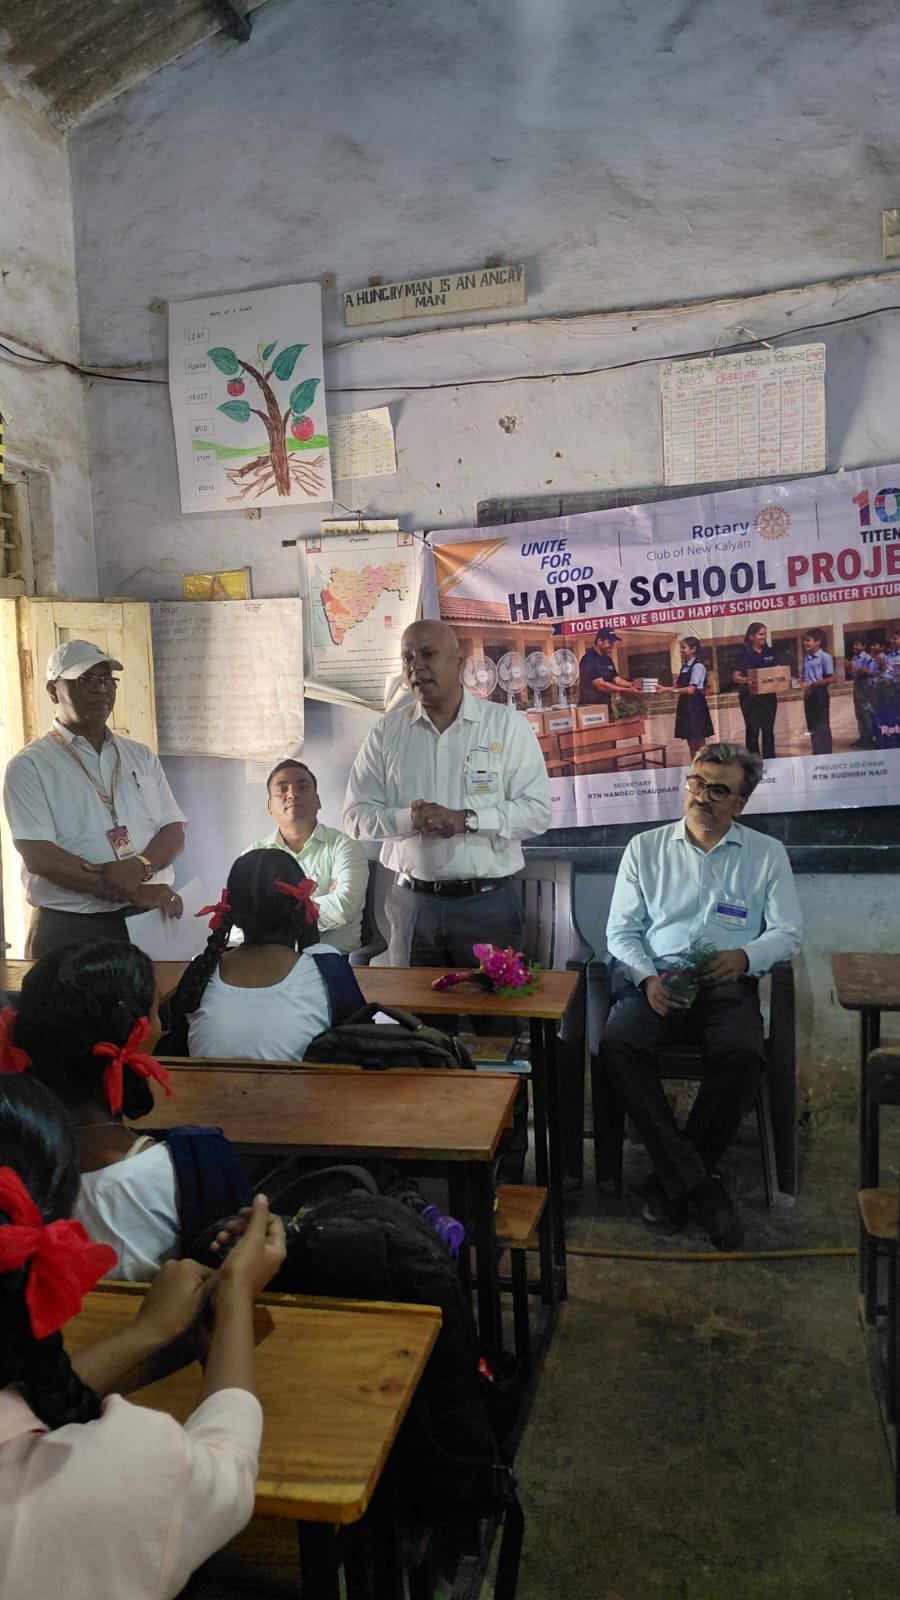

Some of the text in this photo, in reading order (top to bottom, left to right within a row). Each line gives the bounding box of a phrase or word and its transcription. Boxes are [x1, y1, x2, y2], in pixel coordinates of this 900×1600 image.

[346, 268, 523, 308] A HUNGRY MAN IS AN ANGRY
[415, 294, 446, 309] MAN
[187, 331, 205, 341] LEAF
[190, 392, 208, 401] FRUIT
[692, 521, 750, 540] Rotary
[520, 538, 568, 557] UNITE
[646, 540, 751, 562] Club of New Kalyan
[540, 552, 572, 570] FOR
[508, 543, 900, 623] HAPPY SCHOOL PROJE
[546, 566, 594, 585] GOOD
[570, 616, 627, 633] TOGETHER
[630, 612, 648, 625] WE
[651, 608, 685, 623] BUILD
[688, 603, 726, 618] HAPPY
[730, 597, 784, 613] SCHOOLS
[788, 596, 797, 606] &
[800, 588, 860, 605] BRIGHTER
[830, 770, 866, 780] SUDHISH
[868, 768, 888, 776] NAIR
[604, 790, 636, 798] NAMDEO
[636, 786, 680, 796] CHAUDHARI
[613, 780, 652, 789] SECRETARY
